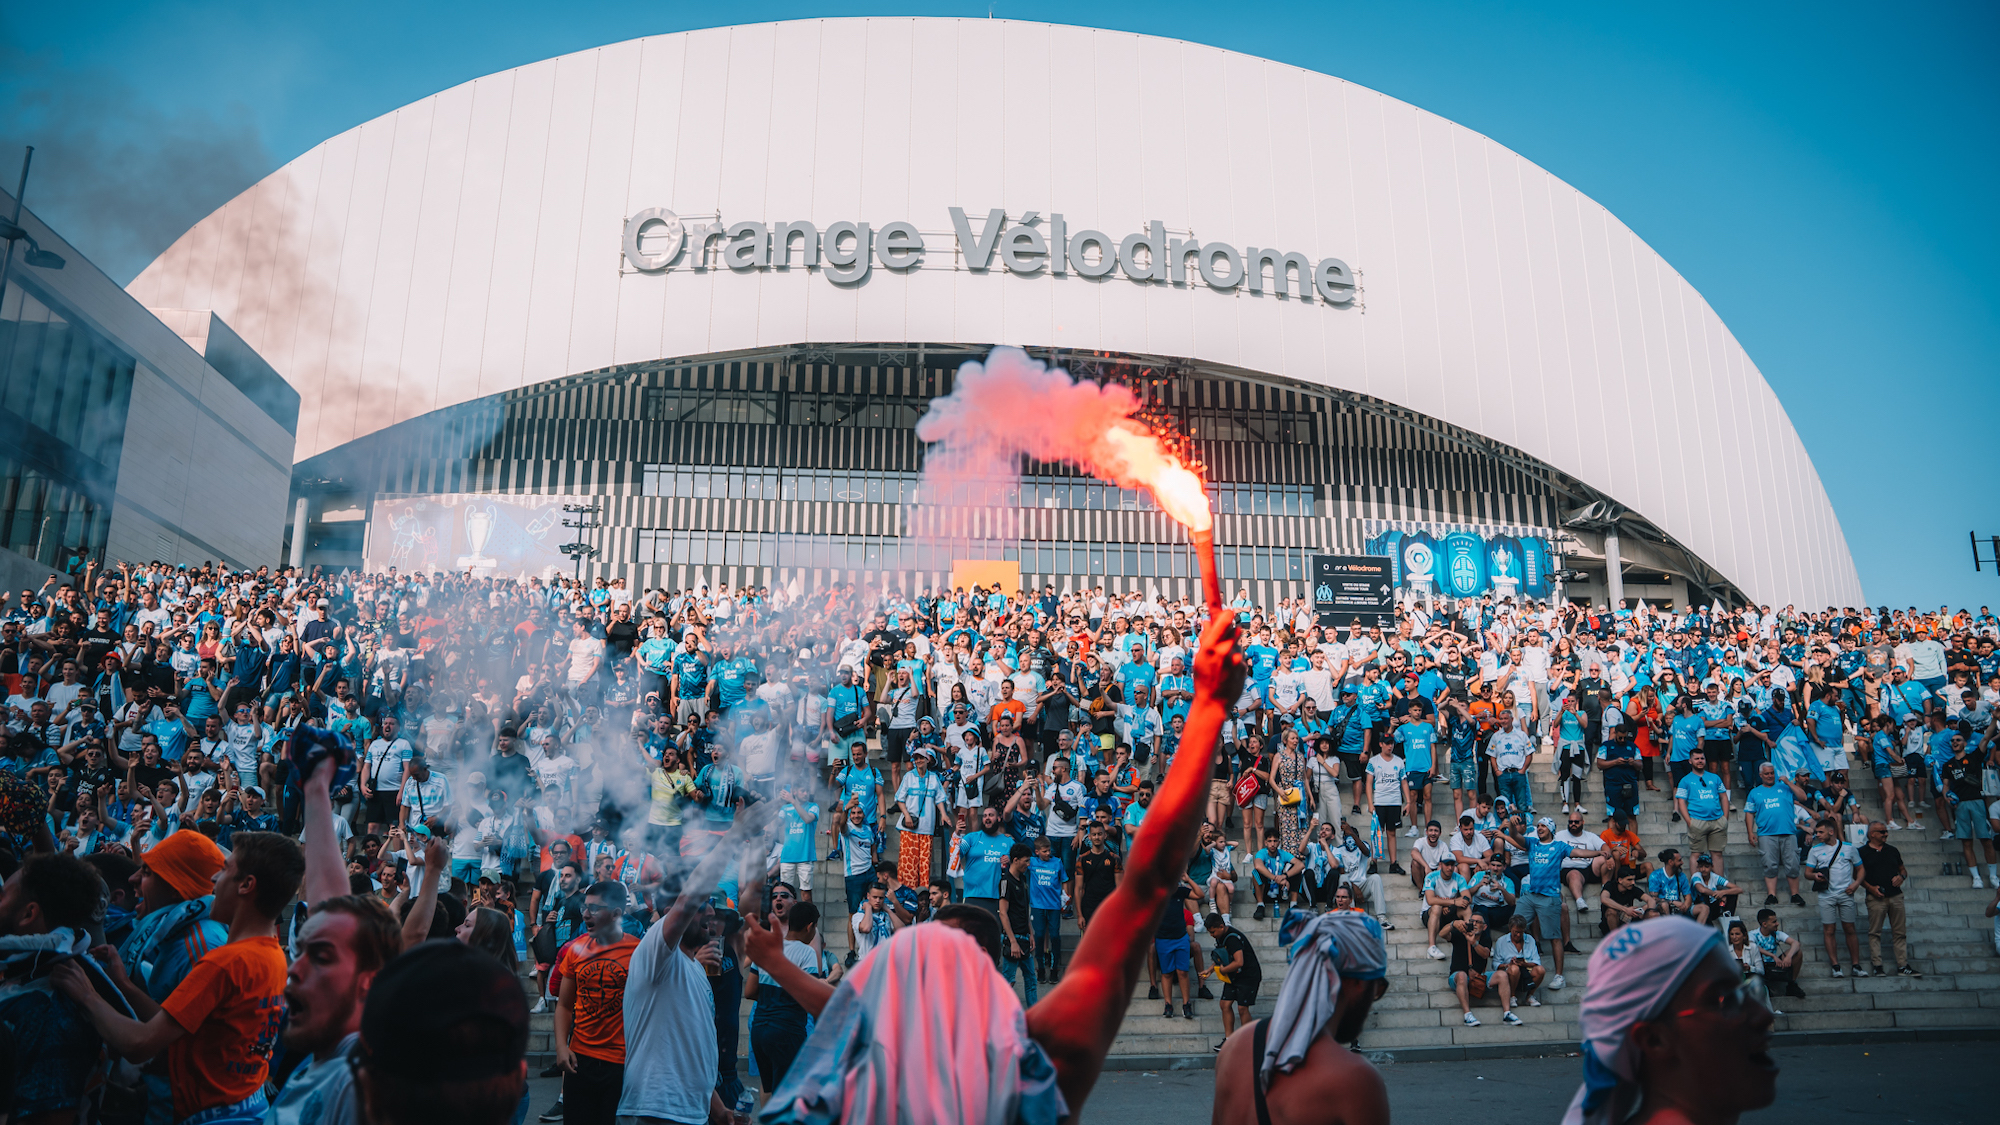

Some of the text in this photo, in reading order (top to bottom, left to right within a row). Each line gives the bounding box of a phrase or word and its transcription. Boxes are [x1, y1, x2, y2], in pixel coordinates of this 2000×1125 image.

[621, 206, 1356, 304] Orange Vélodrome
[124, 841, 148, 850] Orge
